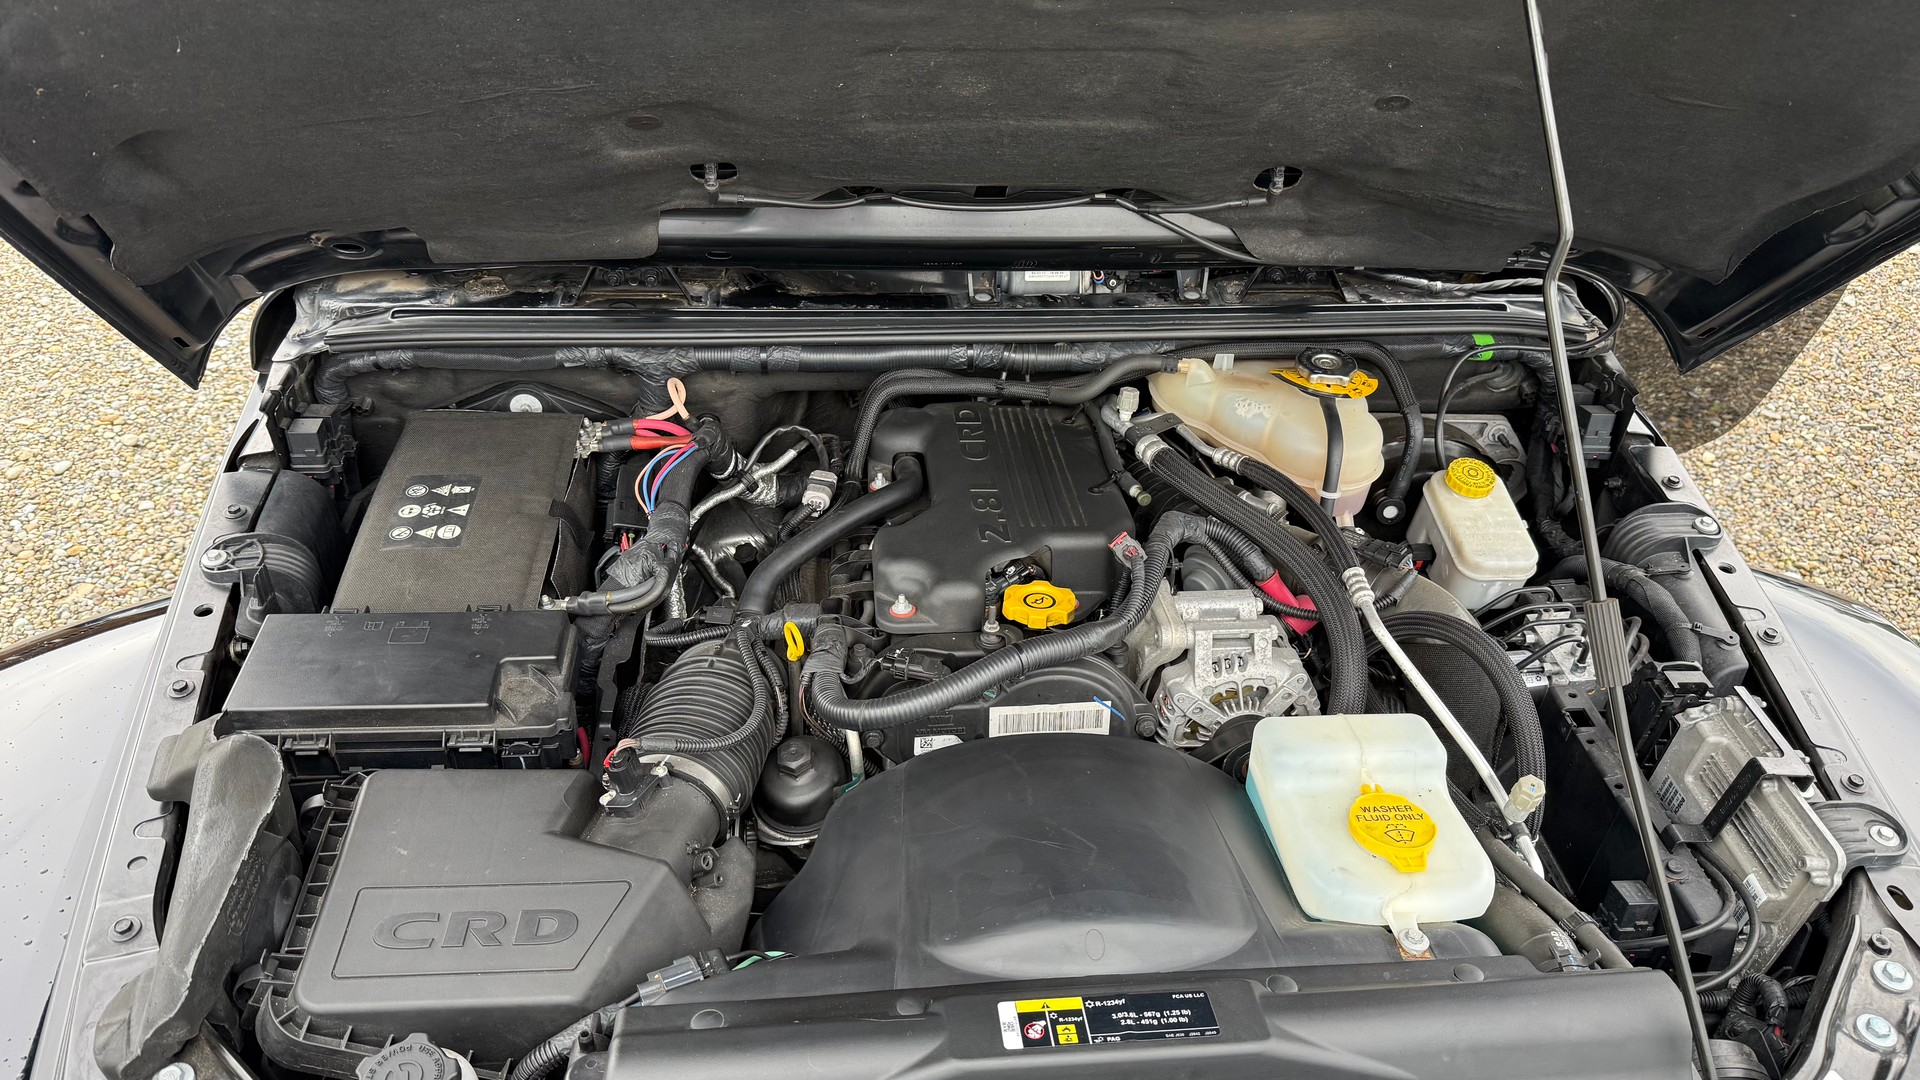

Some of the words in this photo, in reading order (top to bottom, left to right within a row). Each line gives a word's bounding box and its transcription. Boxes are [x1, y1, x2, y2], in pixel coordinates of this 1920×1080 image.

[953, 405, 990, 461] CRD
[1360, 805, 1413, 813] WASHER
[1355, 814, 1391, 822] FLUID
[1394, 813, 1425, 821] ONLY
[372, 908, 579, 949] CRD
[1095, 998, 1126, 1007] R-1234yf
[1163, 1009, 1180, 1017] (1.25
[375, 1044, 413, 1067] POWER
[418, 1045, 436, 1058] USE
